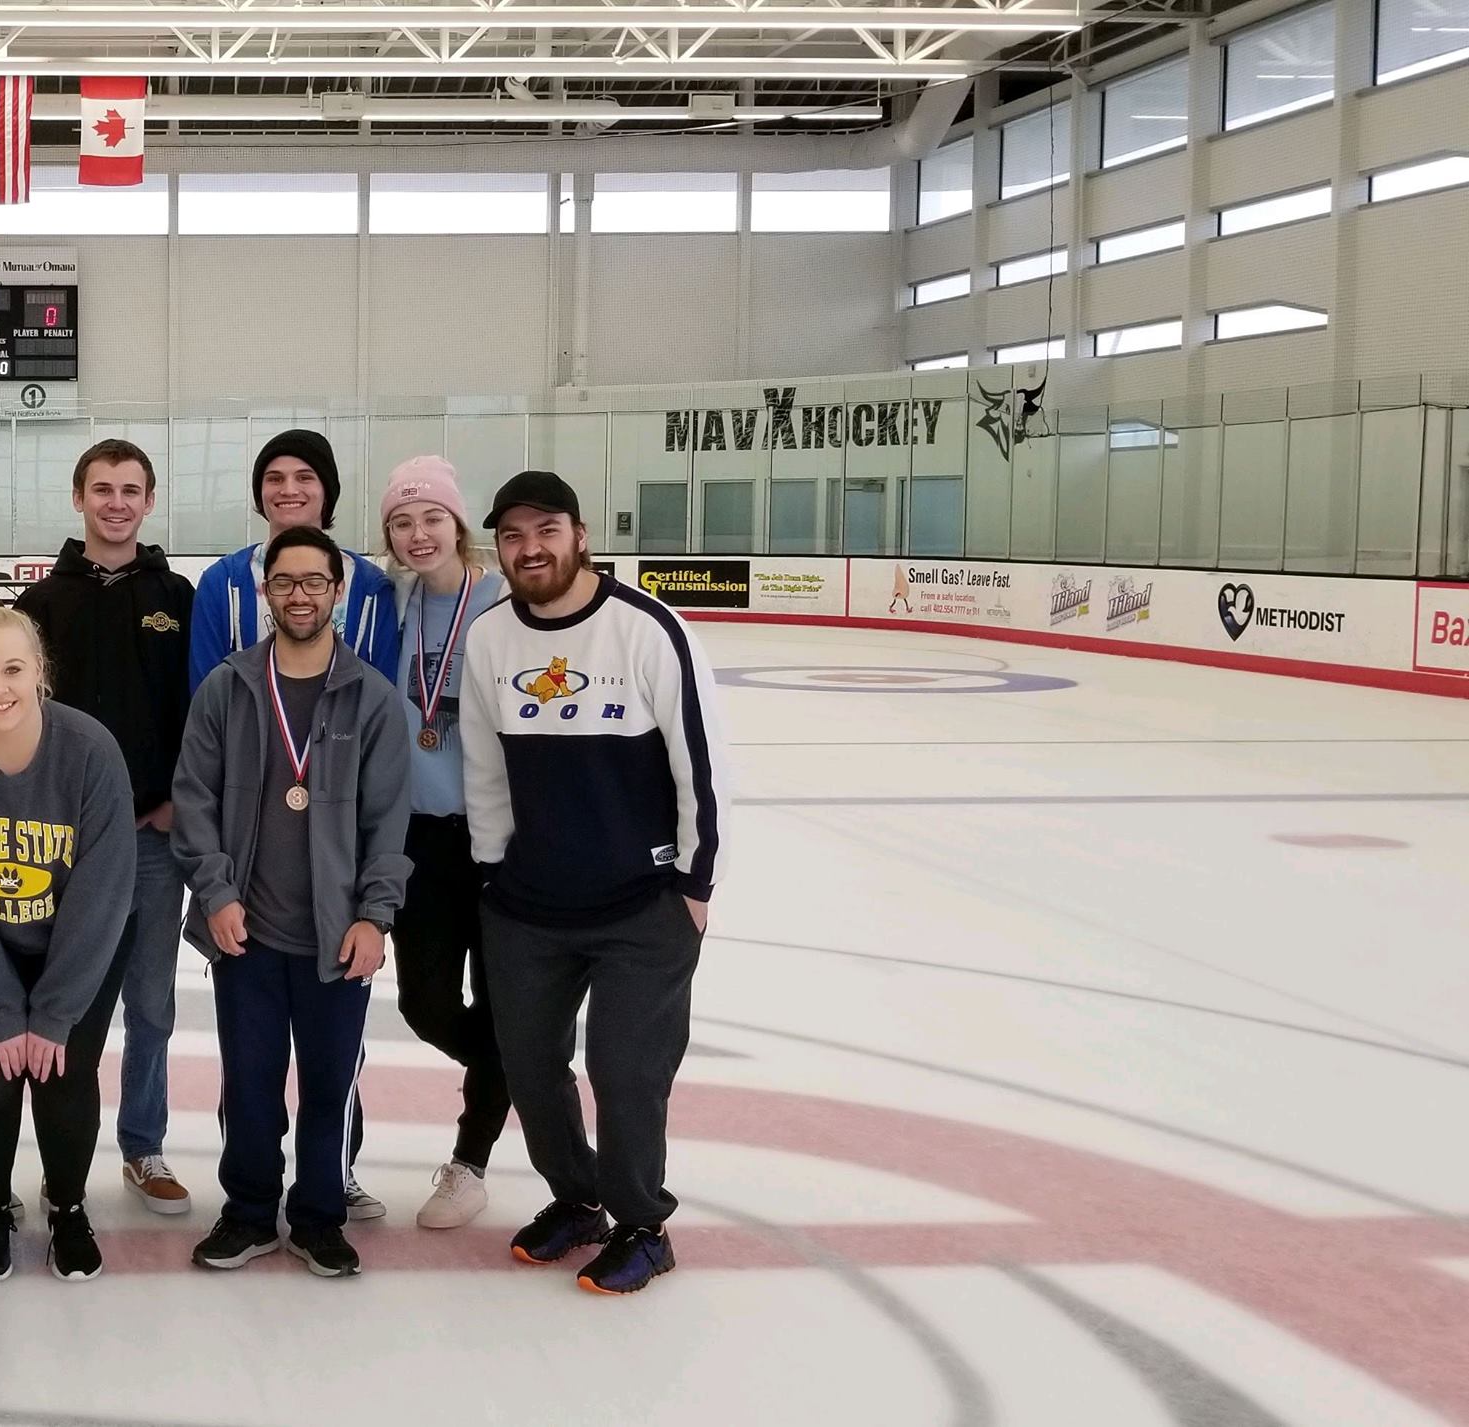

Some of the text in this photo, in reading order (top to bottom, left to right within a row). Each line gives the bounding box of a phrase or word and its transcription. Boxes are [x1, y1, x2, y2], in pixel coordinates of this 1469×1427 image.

[13, 329, 73, 337] PLAYER PENALTY
[0, 361, 9, 375] 0
[640, 571, 711, 589] Certified
[908, 567, 1011, 588] Smell Gas? Leave Fast.
[648, 581, 748, 598] Transmission
[920, 591, 935, 600] From
[942, 593, 954, 601] safe
[1050, 579, 1092, 615] Hiland
[920, 604, 932, 612] call
[1107, 582, 1154, 620] Hiland
[1255, 607, 1345, 633] METHODIST
[292, 791, 303, 805] 3
[16, 820, 75, 869] STATE
